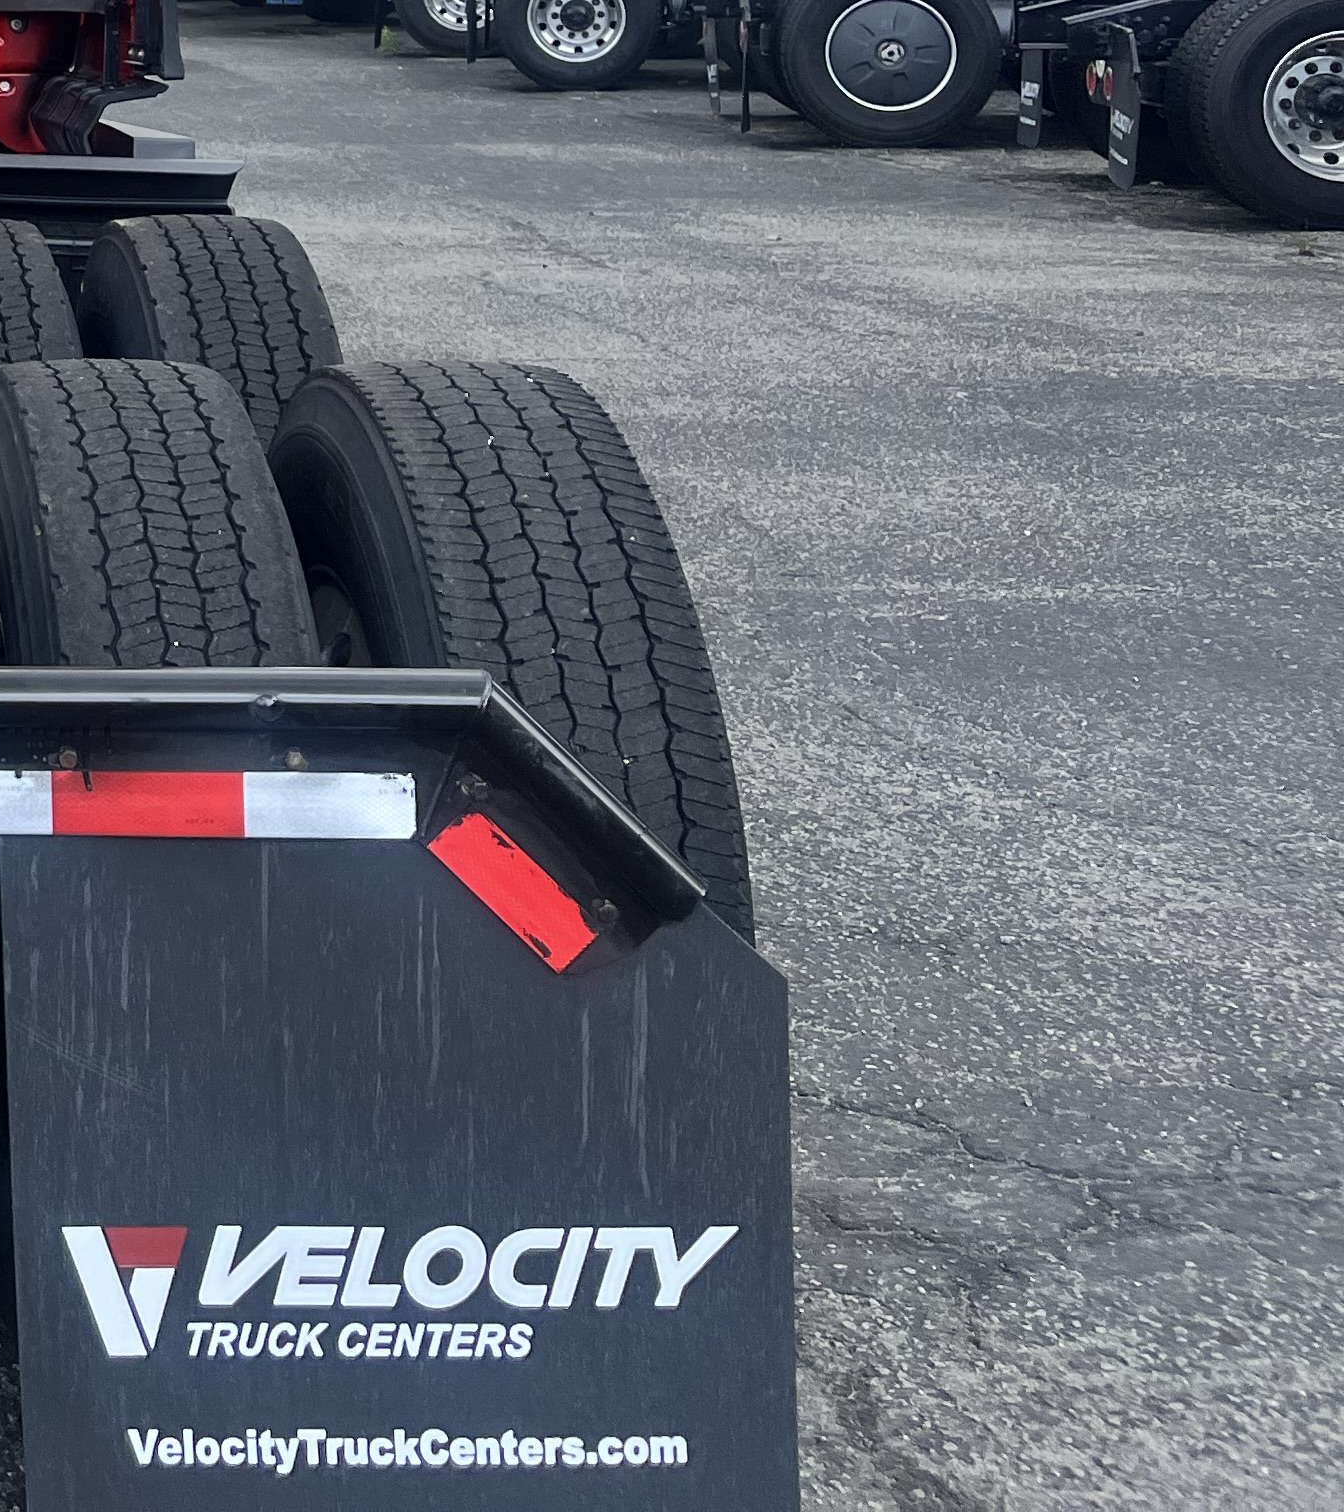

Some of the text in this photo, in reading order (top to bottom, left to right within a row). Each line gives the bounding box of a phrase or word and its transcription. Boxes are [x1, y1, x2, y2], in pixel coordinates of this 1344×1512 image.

[198, 1224, 740, 1310] VELOCITY
[186, 1321, 534, 1360] TRUCK CENTERS
[127, 1428, 688, 1476] VelocityTruckCenters.com
